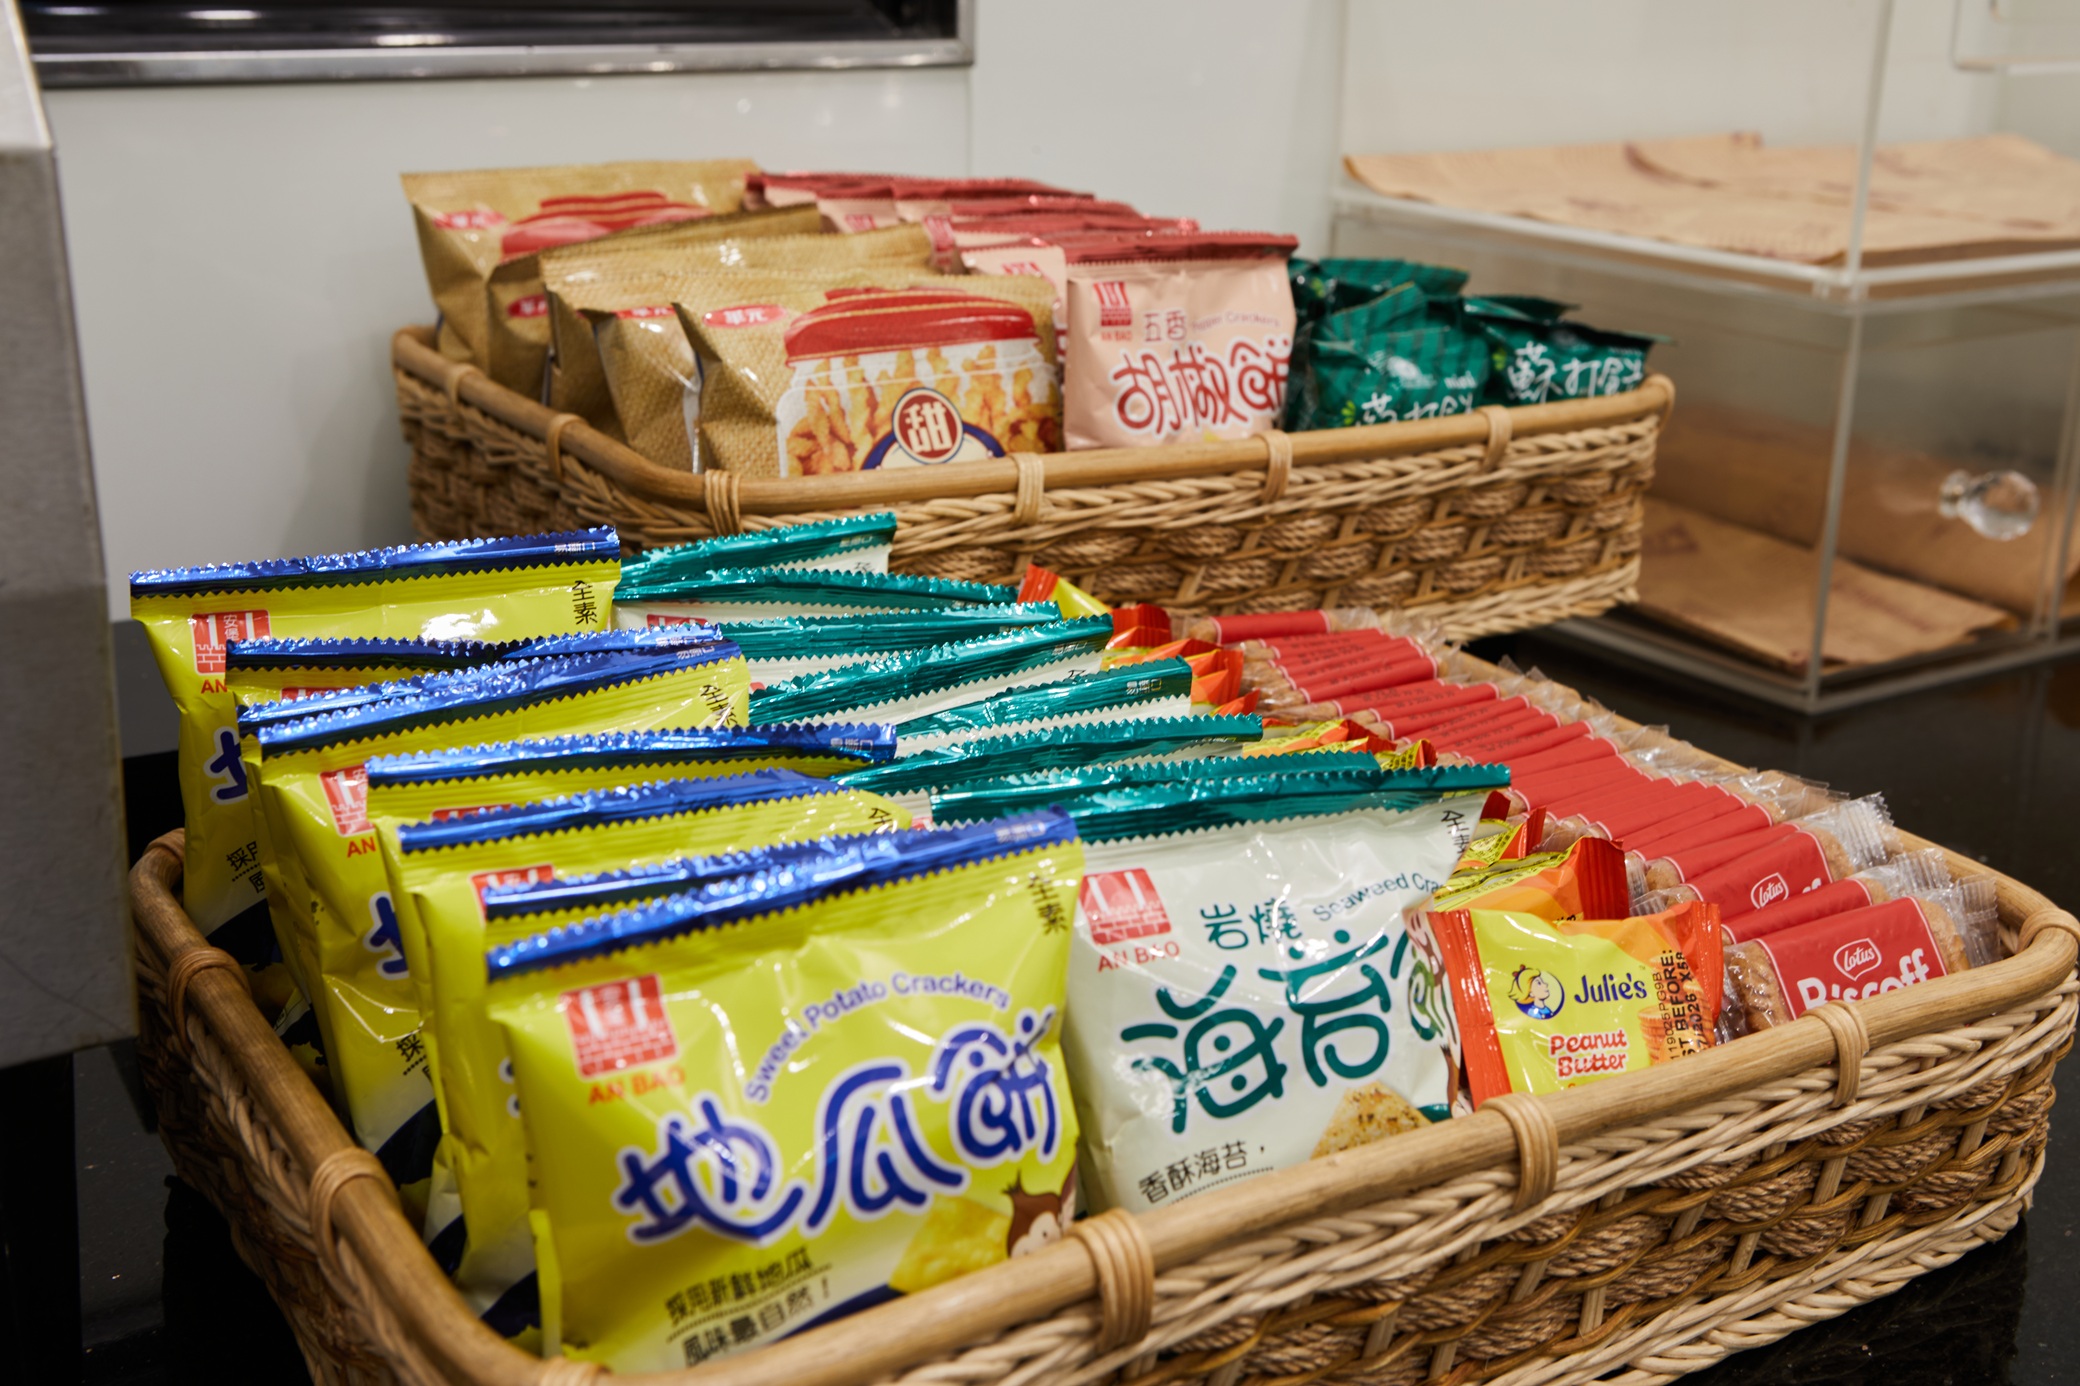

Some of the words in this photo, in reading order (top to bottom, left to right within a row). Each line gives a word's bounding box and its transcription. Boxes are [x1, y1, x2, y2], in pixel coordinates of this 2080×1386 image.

[1144, 310, 1186, 342] 五香
[903, 401, 953, 453] 甜
[572, 580, 598, 625] 全素
[200, 679, 228, 694] AN
[347, 836, 376, 858] AN
[1313, 873, 1410, 922] Seaweed
[1411, 872, 1443, 894] Cra
[1758, 880, 1784, 907] Lotus
[1844, 947, 1876, 972] Lotus
[1574, 972, 1647, 1004] Julie's
[1661, 950, 1689, 1031] BEFORE:
[747, 1021, 808, 1102] Sweet
[805, 981, 887, 1027] Potato
[892, 970, 1009, 1009] Crackers
[1550, 1030, 1627, 1055] Peanut
[1558, 1052, 1627, 1078] Butter
[588, 1079, 625, 1105] AN
[631, 1066, 686, 1097] BAO
[616, 1014, 1058, 1240] 地瓜餅
